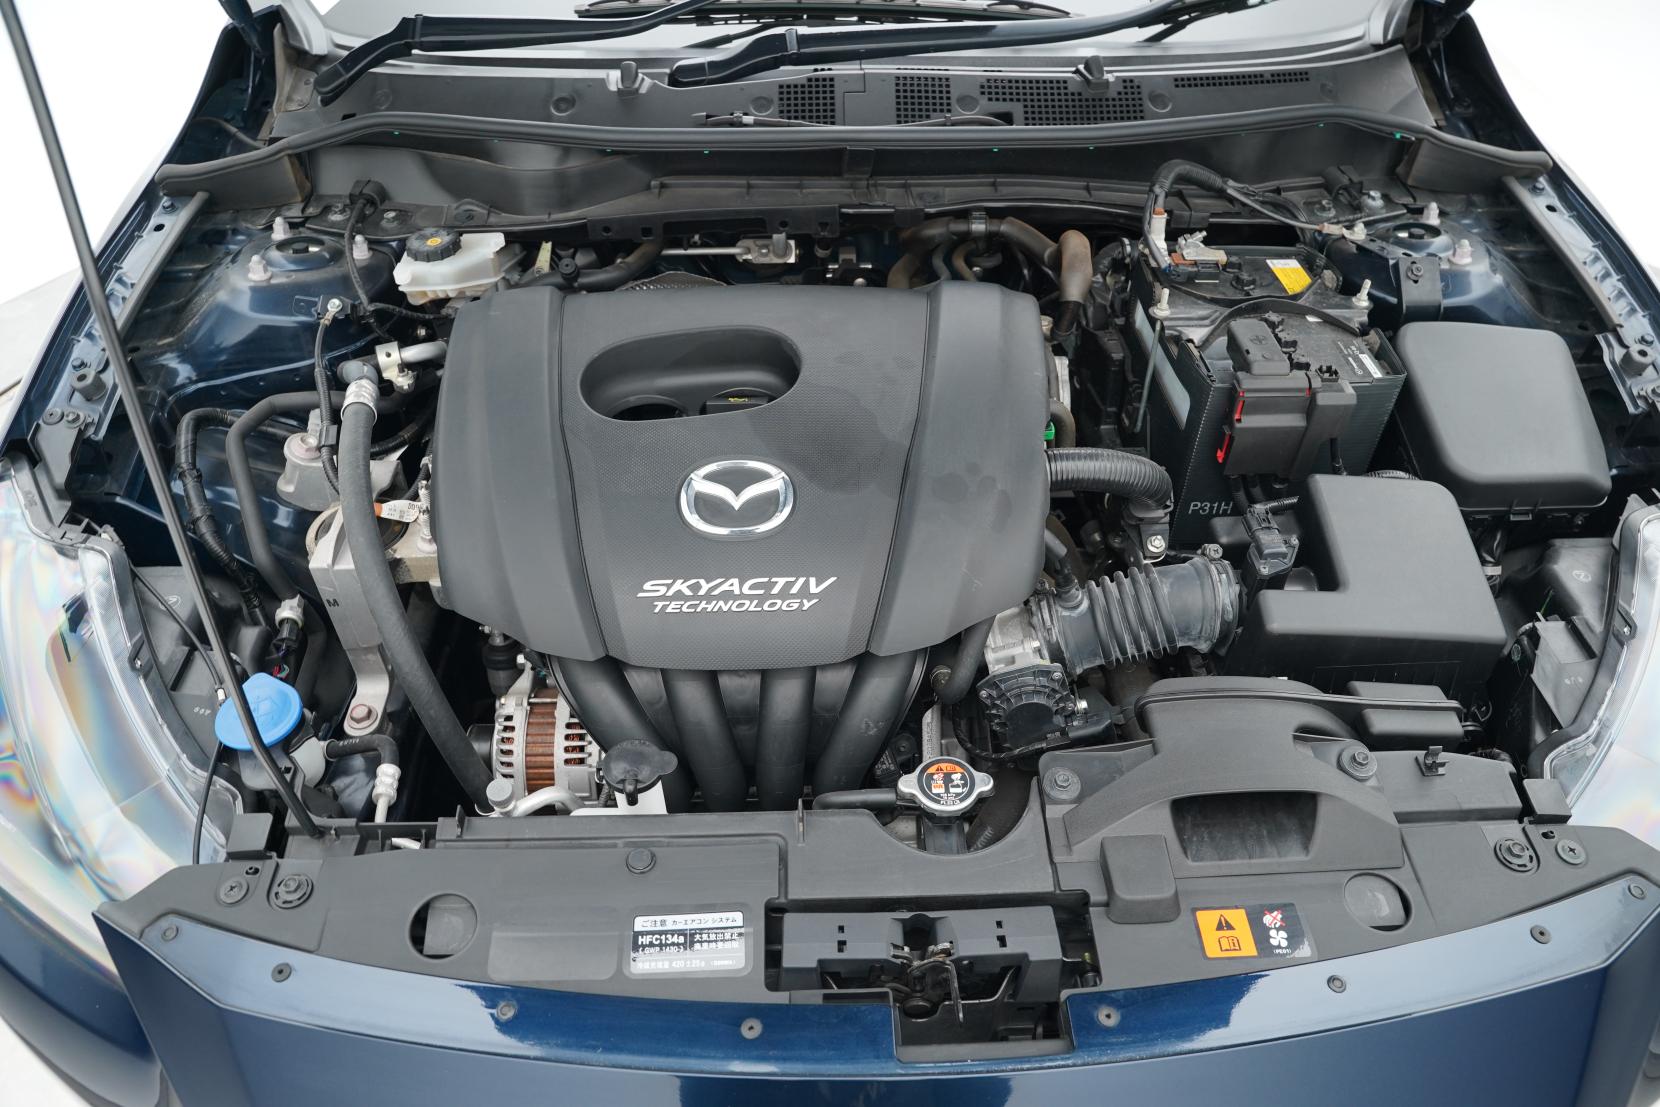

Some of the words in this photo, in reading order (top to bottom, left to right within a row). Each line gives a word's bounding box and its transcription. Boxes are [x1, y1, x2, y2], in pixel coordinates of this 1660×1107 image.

[1188, 501, 1233, 515] P31H
[636, 576, 838, 597] SKYACTIV
[653, 599, 820, 613] TECHNOLOGY
[641, 919, 668, 928] ご注意
[638, 934, 685, 945] HFC134a
